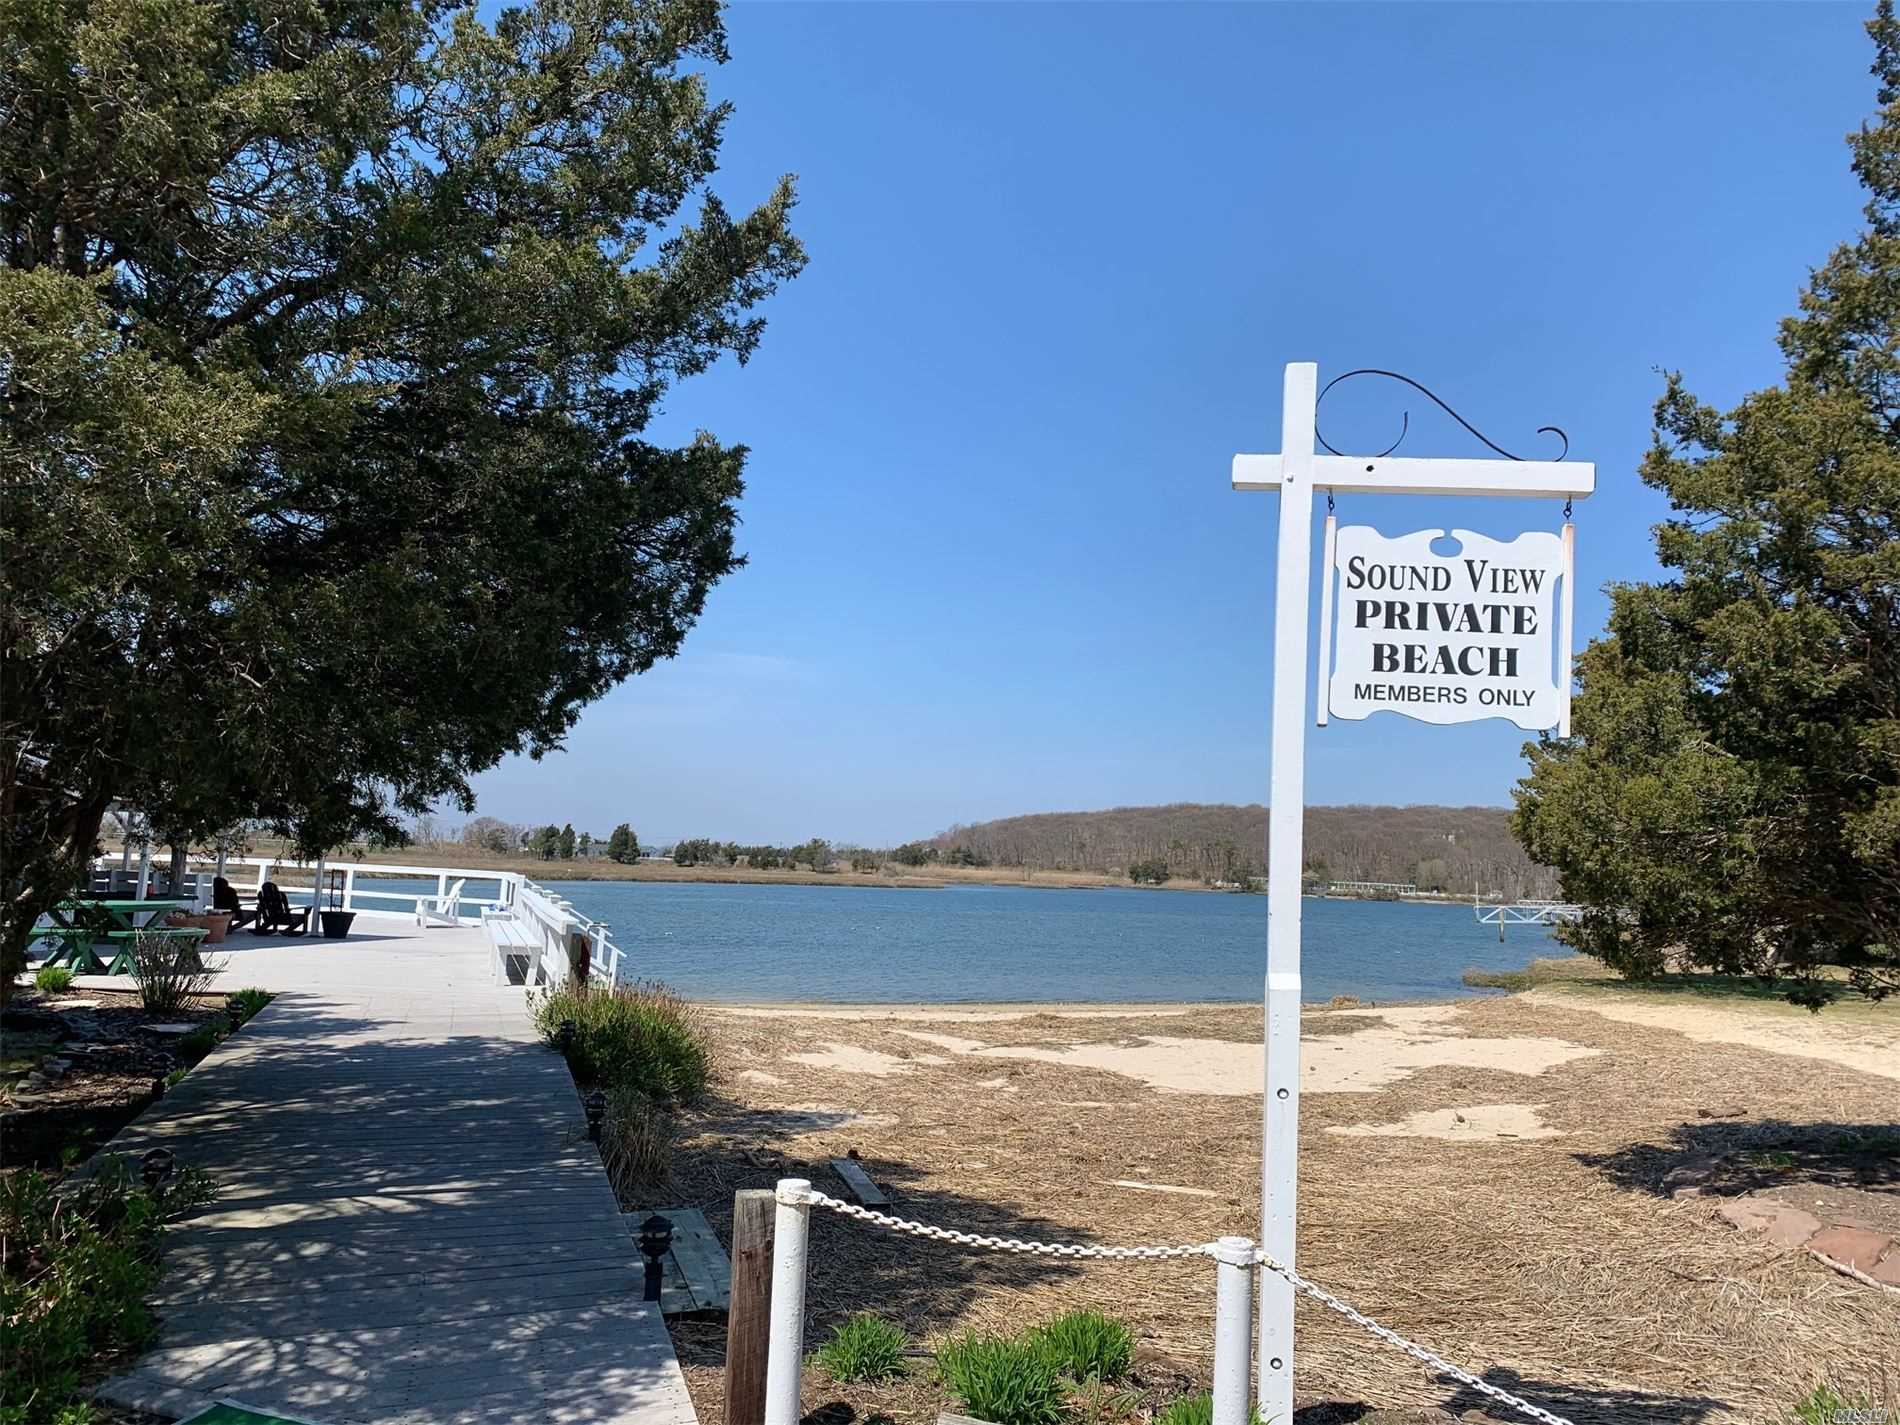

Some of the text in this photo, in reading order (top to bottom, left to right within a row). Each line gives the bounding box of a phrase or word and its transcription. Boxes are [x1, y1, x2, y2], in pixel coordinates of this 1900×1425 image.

[1346, 556, 1546, 594] SOUND VIEW
[1354, 599, 1538, 635] PRIVATE
[1371, 643, 1519, 678] BEACH
[1354, 683, 1536, 707] MEMBERS ONLY
